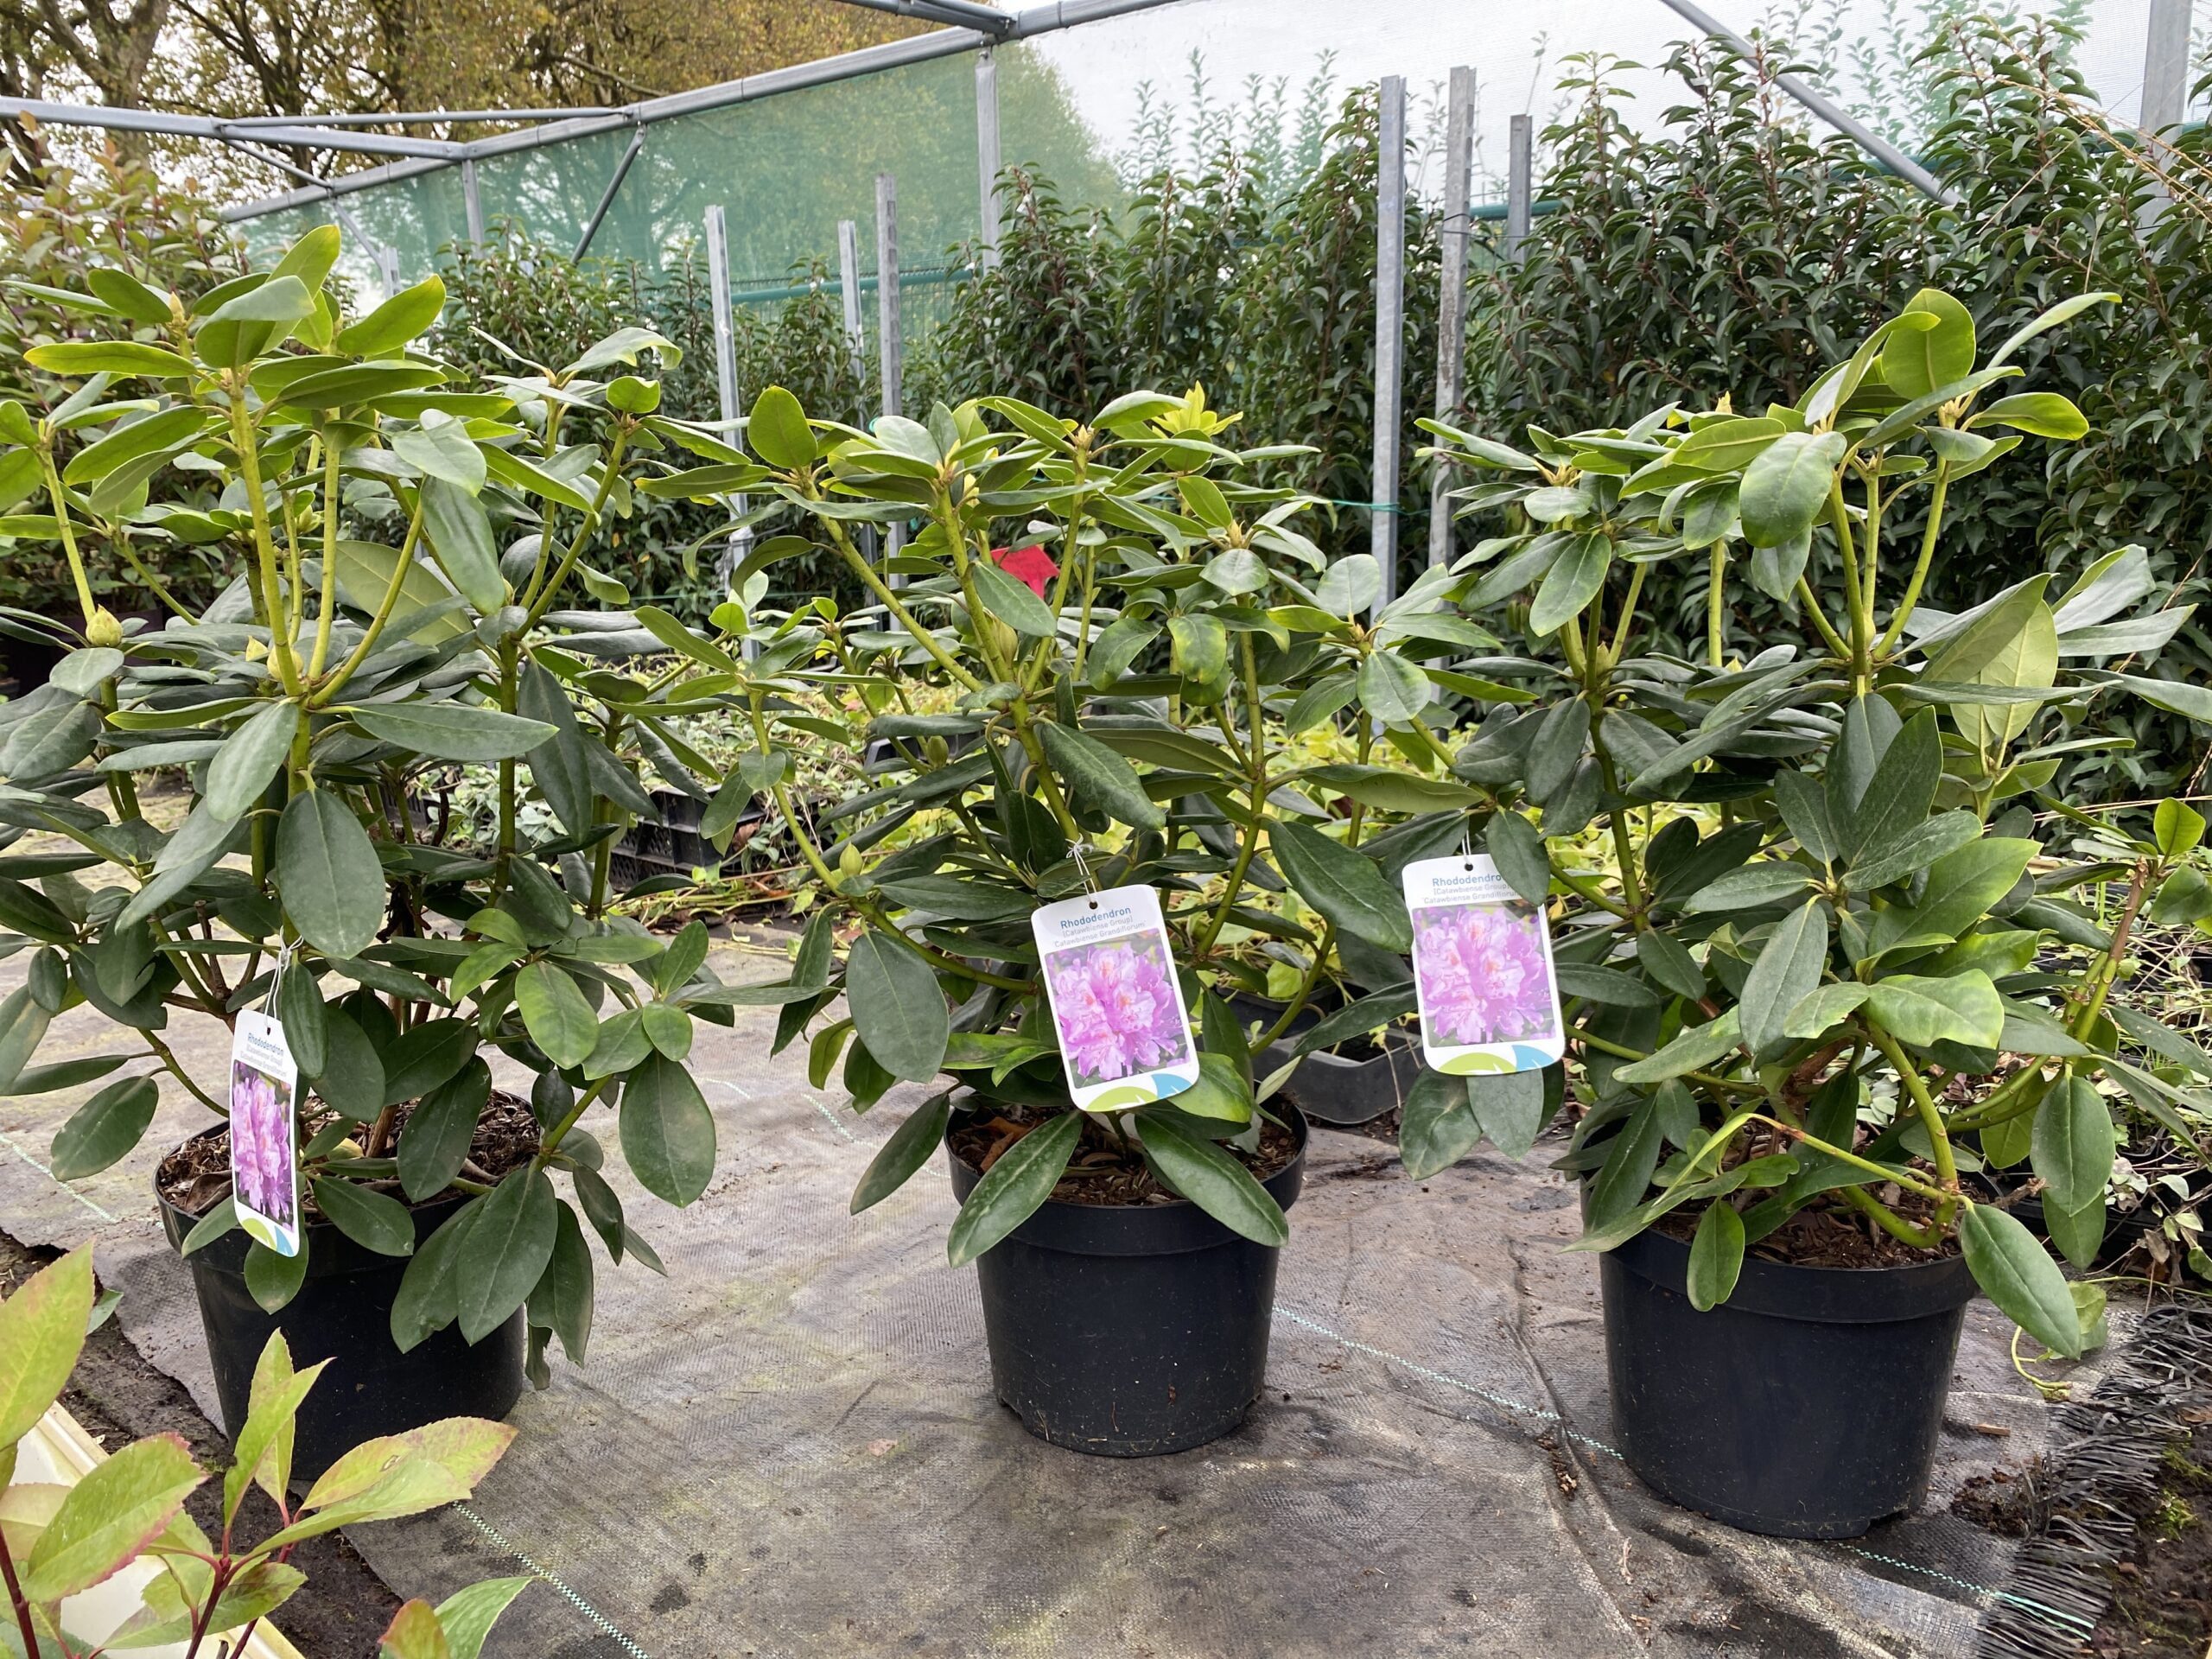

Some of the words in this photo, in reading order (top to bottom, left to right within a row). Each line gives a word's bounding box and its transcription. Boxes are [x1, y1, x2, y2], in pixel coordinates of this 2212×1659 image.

[1432, 874, 1502, 887] Rhododendro
[1060, 907, 1131, 929] Rhododendron
[247, 1032, 284, 1056] Rhododendron
